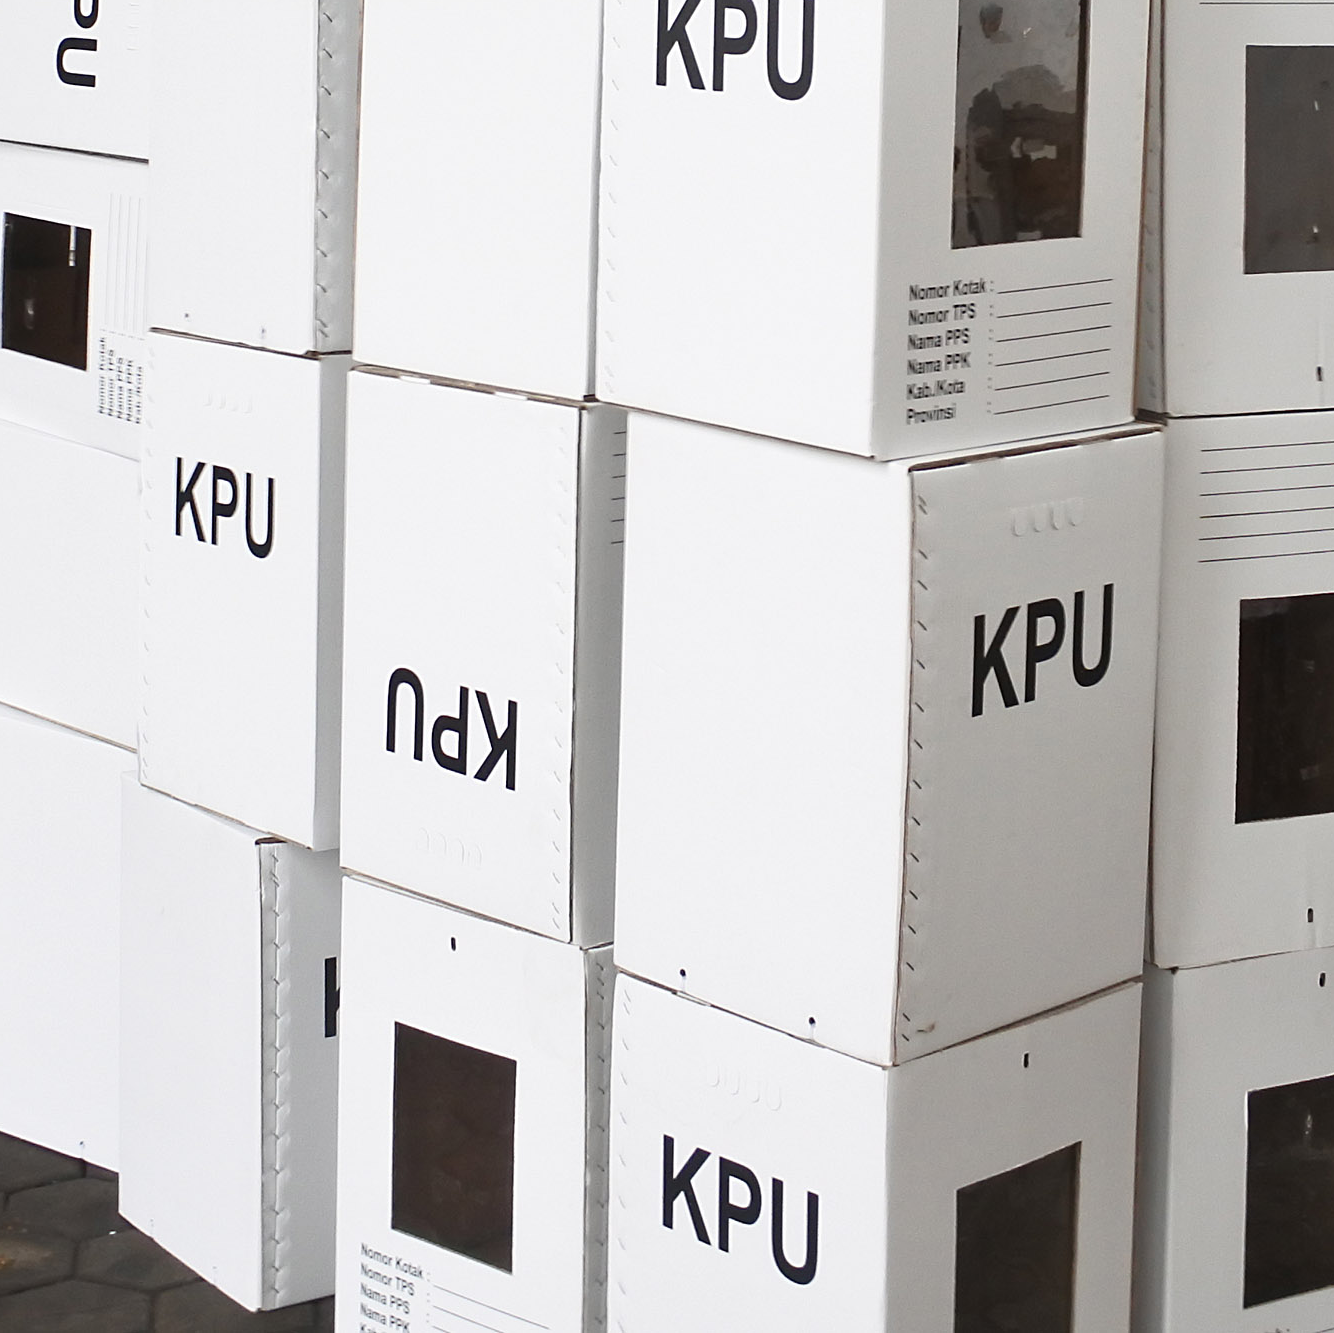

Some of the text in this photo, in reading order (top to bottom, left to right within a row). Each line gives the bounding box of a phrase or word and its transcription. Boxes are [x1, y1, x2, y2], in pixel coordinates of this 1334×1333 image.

[909, 278, 986, 301] Nomor Kotak
[908, 302, 976, 326] Nomor TPS
[907, 327, 970, 351] Nama PPS
[907, 352, 971, 375] Nama PPK
[906, 403, 957, 425] Provinsi
[175, 457, 275, 559] KPU
[971, 583, 1114, 718] KPU
[386, 667, 518, 791] KPU
[662, 1134, 819, 1285] KPU
[361, 1243, 423, 1279] Nomor Kotak
[361, 1263, 415, 1296] Nomor TPS
[360, 1283, 410, 1315] Nama PPS
[360, 1303, 387, 1325] Nama
[390, 1315, 410, 1333] PPK
